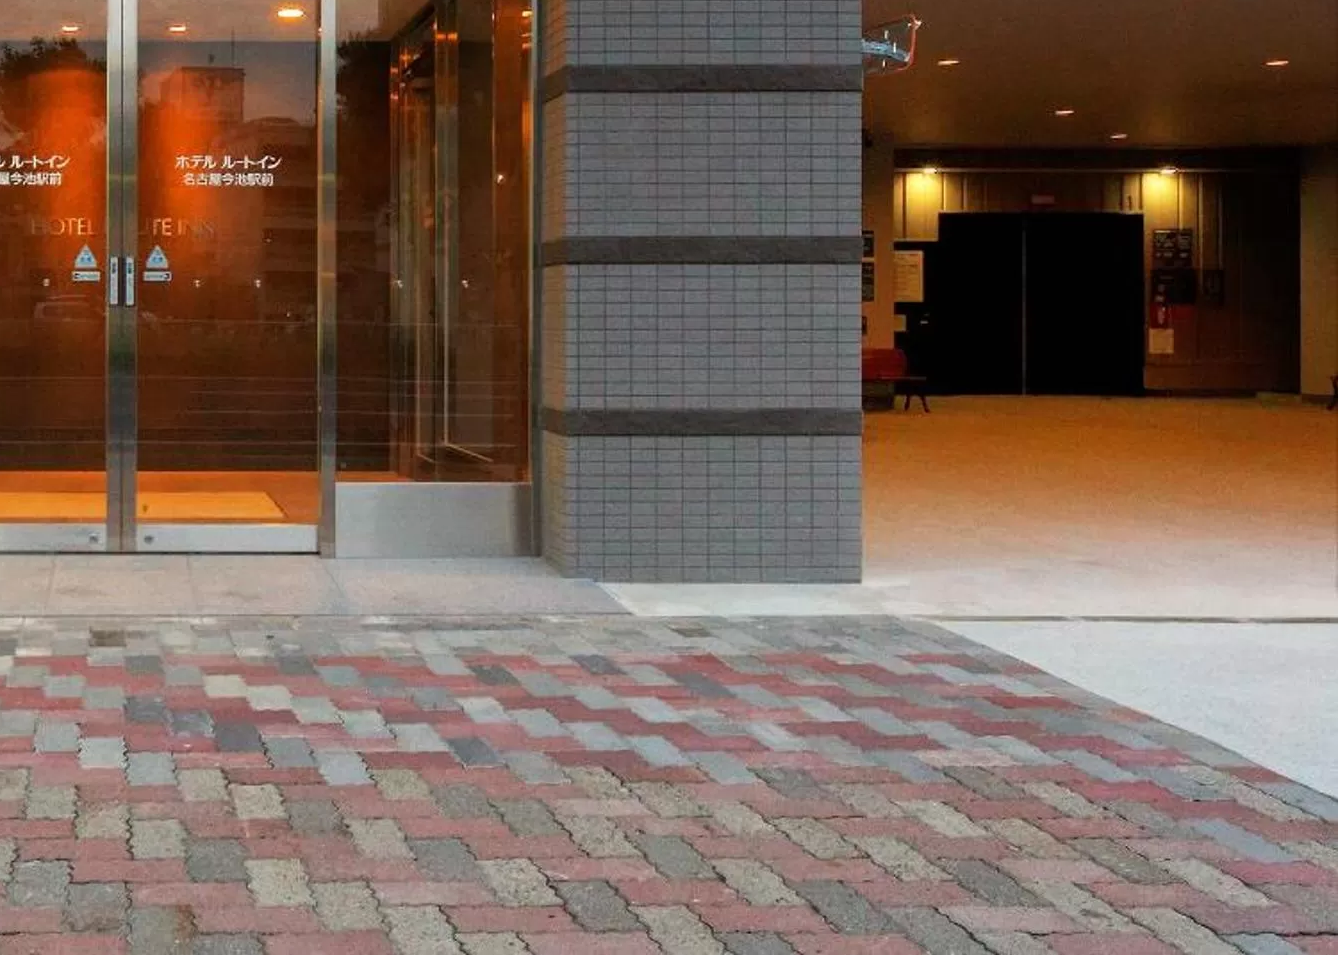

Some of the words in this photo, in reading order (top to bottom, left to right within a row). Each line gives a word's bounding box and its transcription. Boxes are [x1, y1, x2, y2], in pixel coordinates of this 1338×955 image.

[9, 155, 70, 168] ルートイン
[176, 155, 217, 168] ホテル
[221, 155, 282, 168] ルートイン
[31, 217, 95, 235] HOTEL
